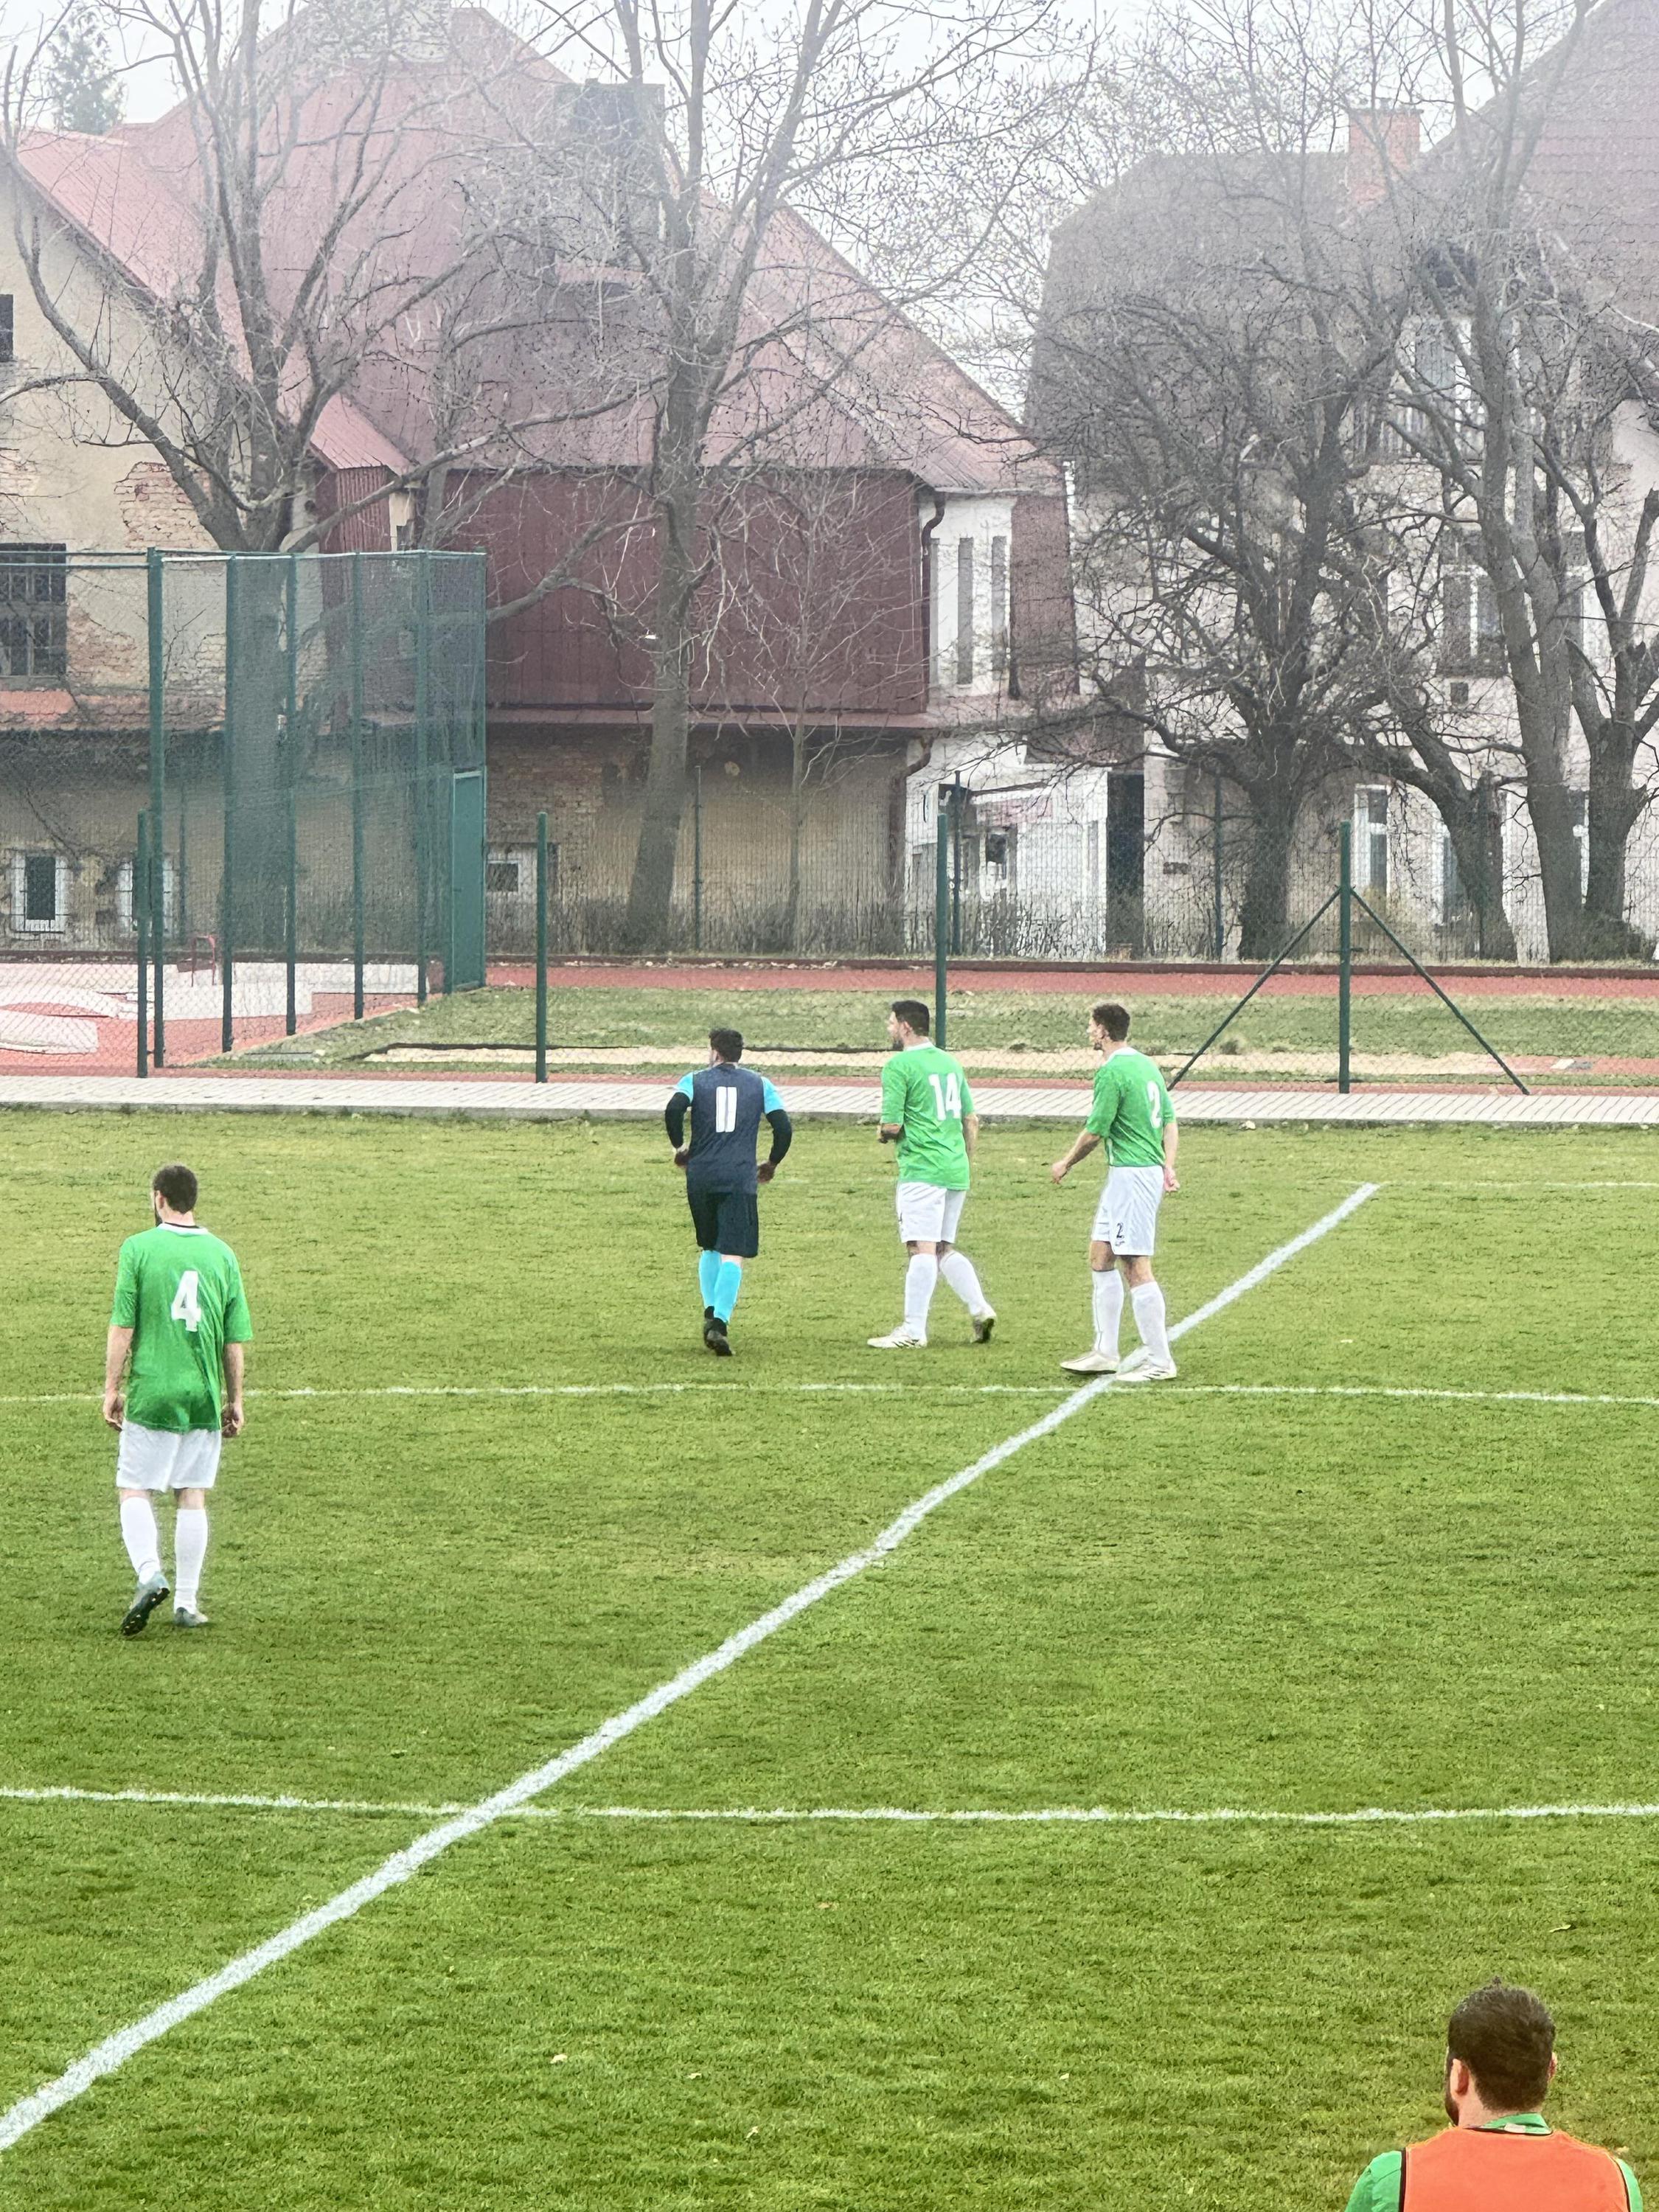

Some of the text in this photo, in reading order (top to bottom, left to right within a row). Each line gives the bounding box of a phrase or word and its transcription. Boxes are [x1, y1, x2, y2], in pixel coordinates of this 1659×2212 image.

[716, 1087, 737, 1133] 11
[928, 1072, 961, 1120] 14
[1147, 1080, 1161, 1128] 2
[1116, 1222, 1124, 1239] 2
[171, 1270, 202, 1332] 4
